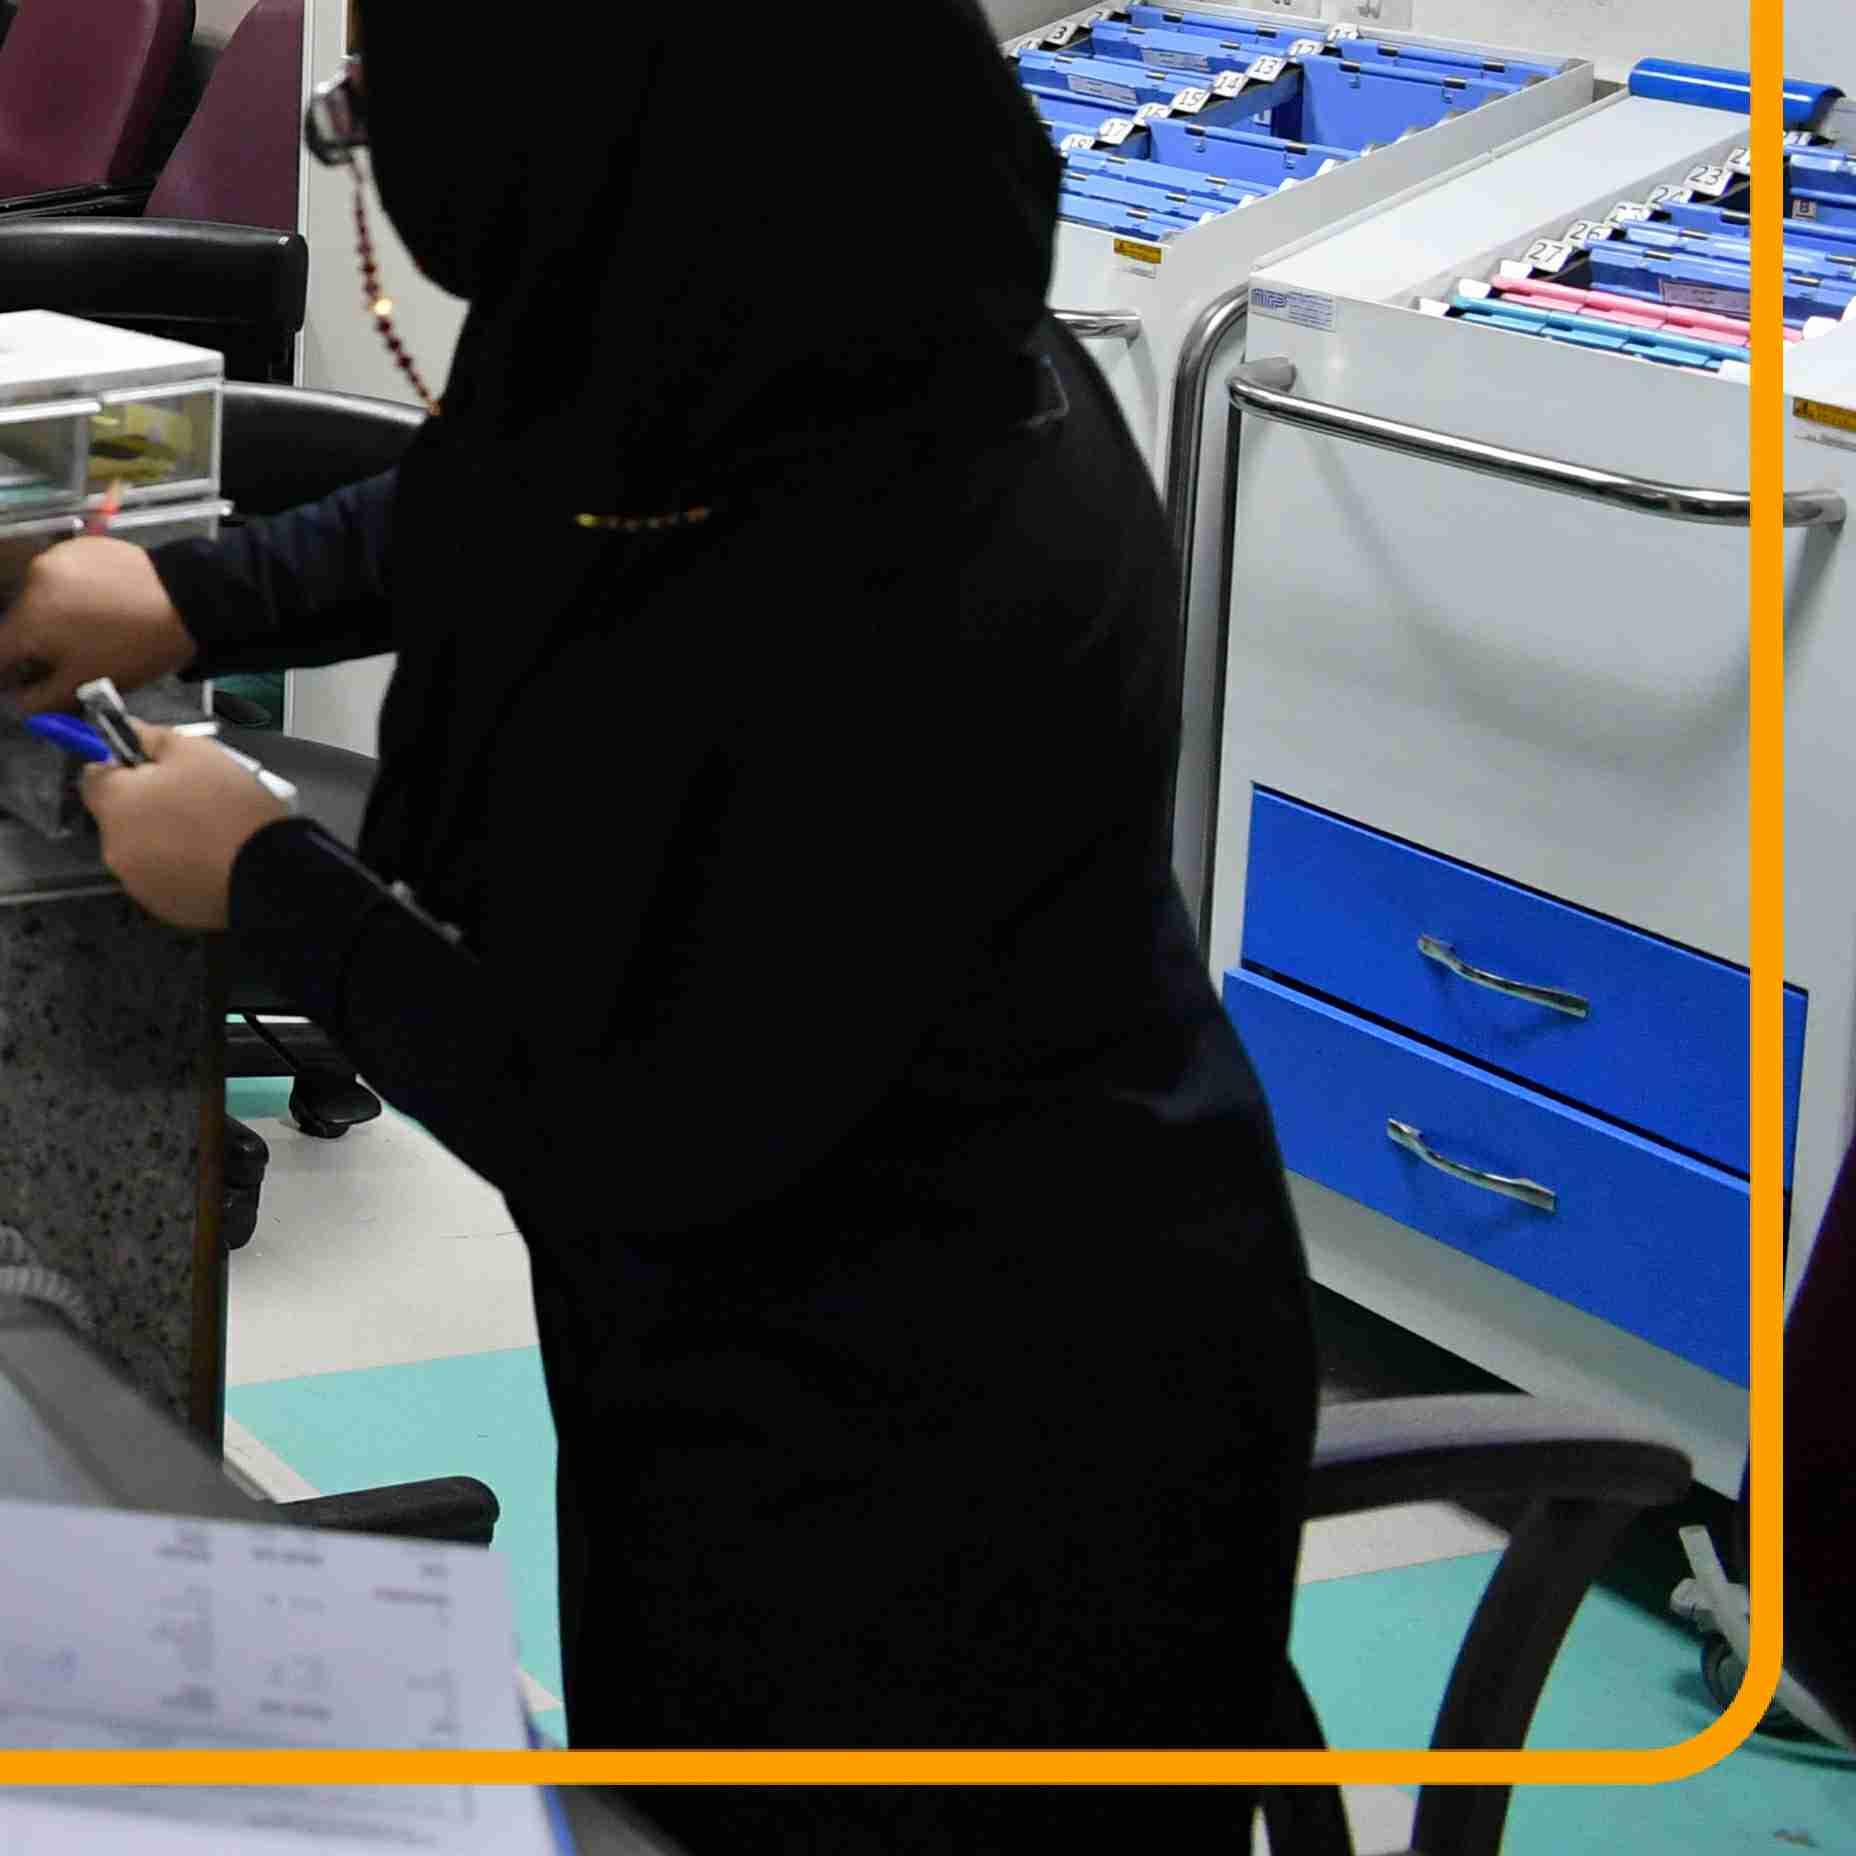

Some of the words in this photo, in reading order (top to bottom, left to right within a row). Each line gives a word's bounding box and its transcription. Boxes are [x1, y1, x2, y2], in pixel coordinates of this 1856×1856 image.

[1054, 26, 1067, 40] 3
[1255, 58, 1276, 75] 13
[1179, 90, 1202, 104] 15
[1690, 165, 1723, 186] 23
[1527, 243, 1563, 263] 27
